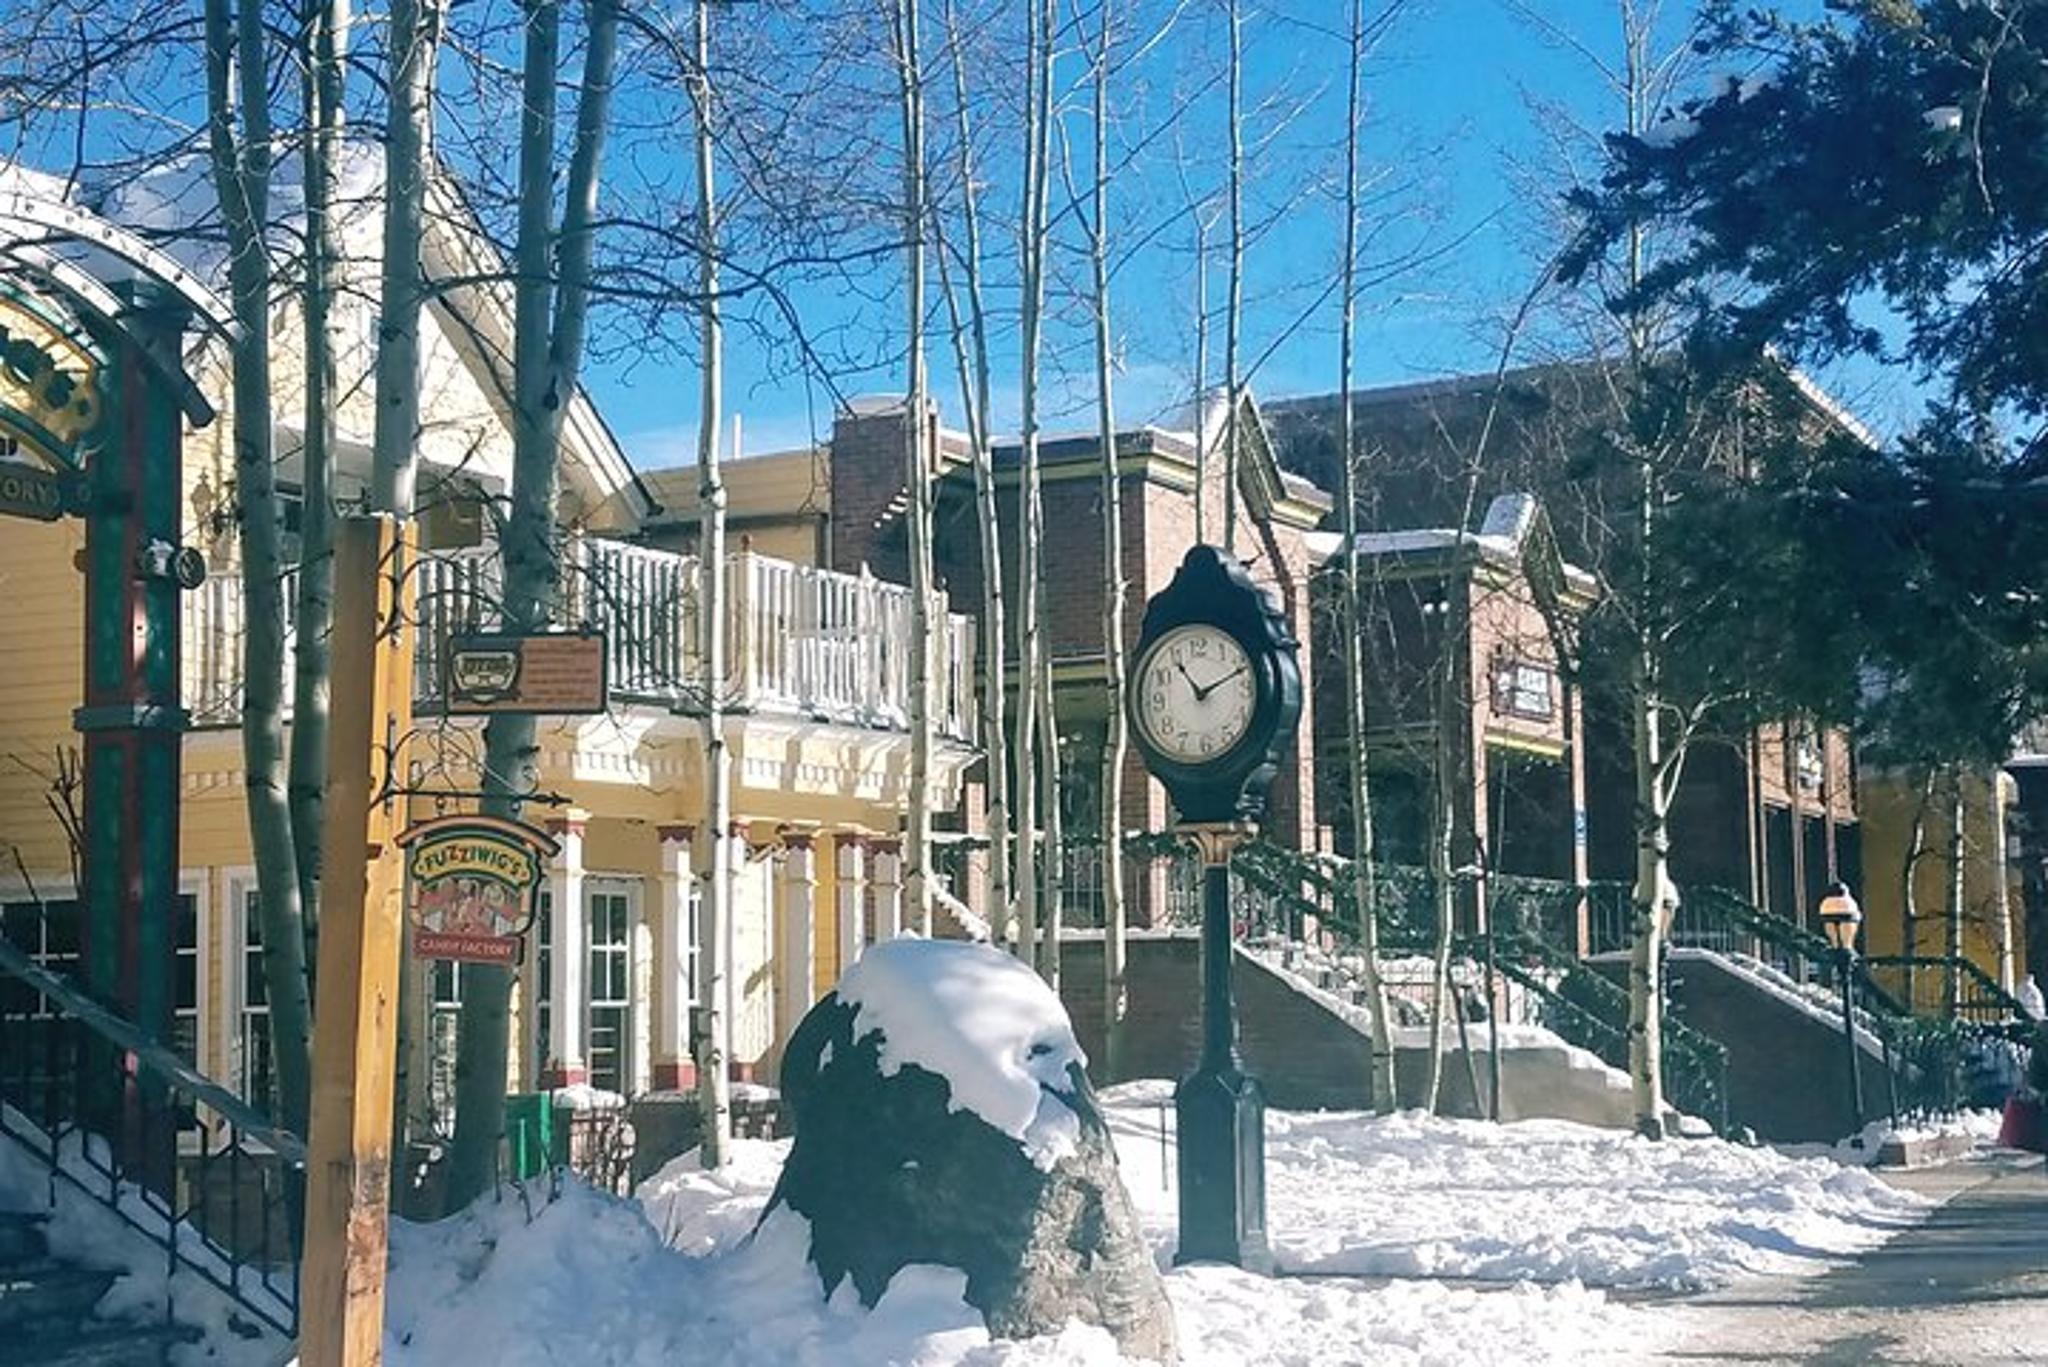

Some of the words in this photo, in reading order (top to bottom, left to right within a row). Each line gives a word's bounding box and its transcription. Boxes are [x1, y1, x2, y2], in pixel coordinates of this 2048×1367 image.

[1190, 639, 1208, 658] 12
[1219, 642, 1226, 661] 1
[1156, 668, 1171, 687] 10
[1153, 691, 1165, 712] 9
[1161, 715, 1174, 735] 8
[1176, 731, 1188, 752] 7
[1200, 734, 1212, 753] 6
[424, 845, 522, 876] FUZZIWIG'S
[460, 940, 513, 956] FACTORY
